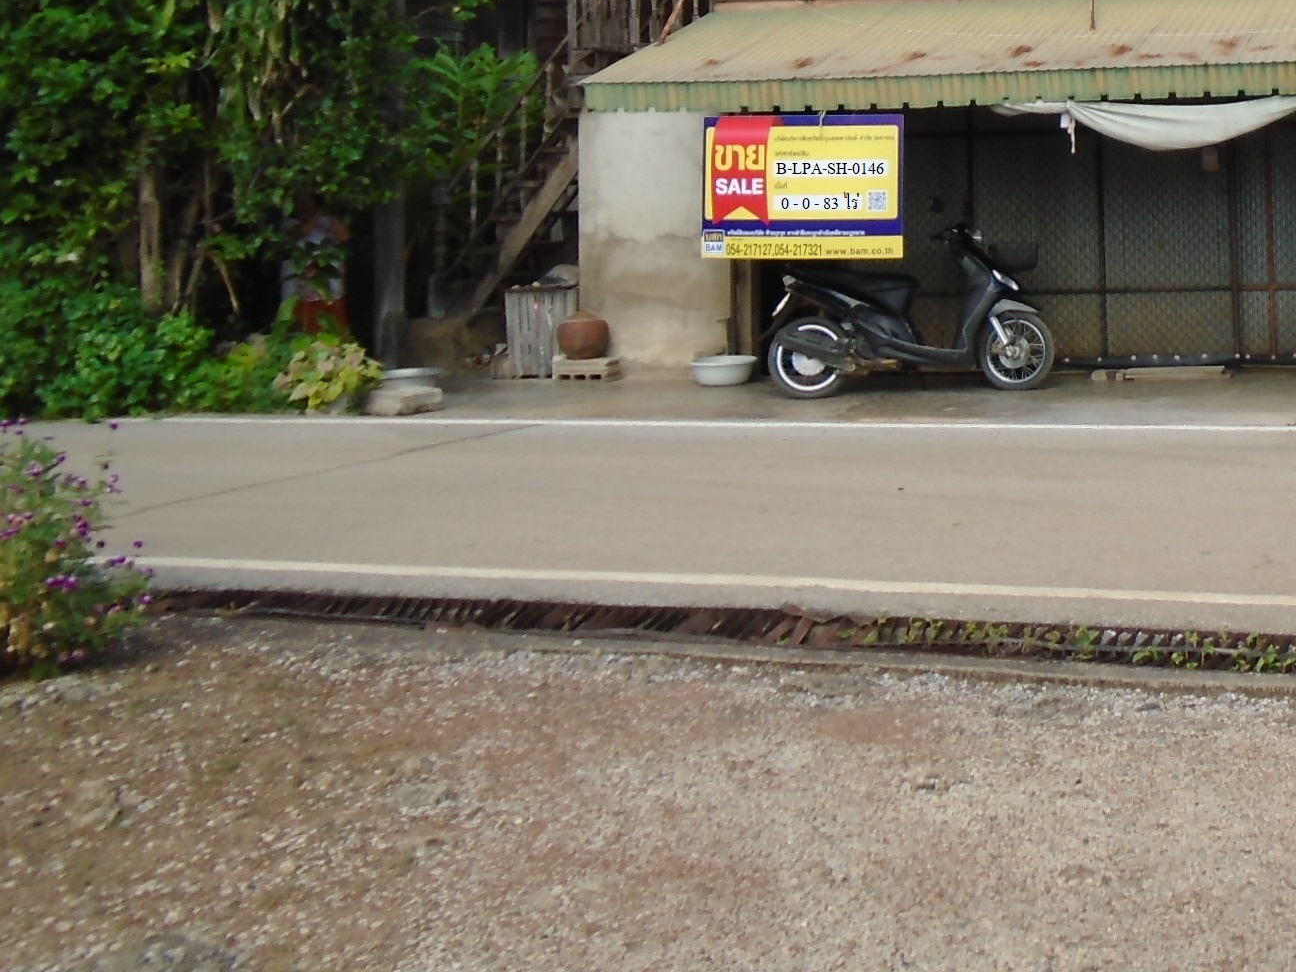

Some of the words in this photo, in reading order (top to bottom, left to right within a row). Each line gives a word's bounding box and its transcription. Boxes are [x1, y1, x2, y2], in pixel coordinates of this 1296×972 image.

[715, 144, 765, 171] ขาย
[715, 177, 764, 195] SALE
[705, 243, 722, 252] BAM
[825, 247, 894, 255] www.bam.co.th
